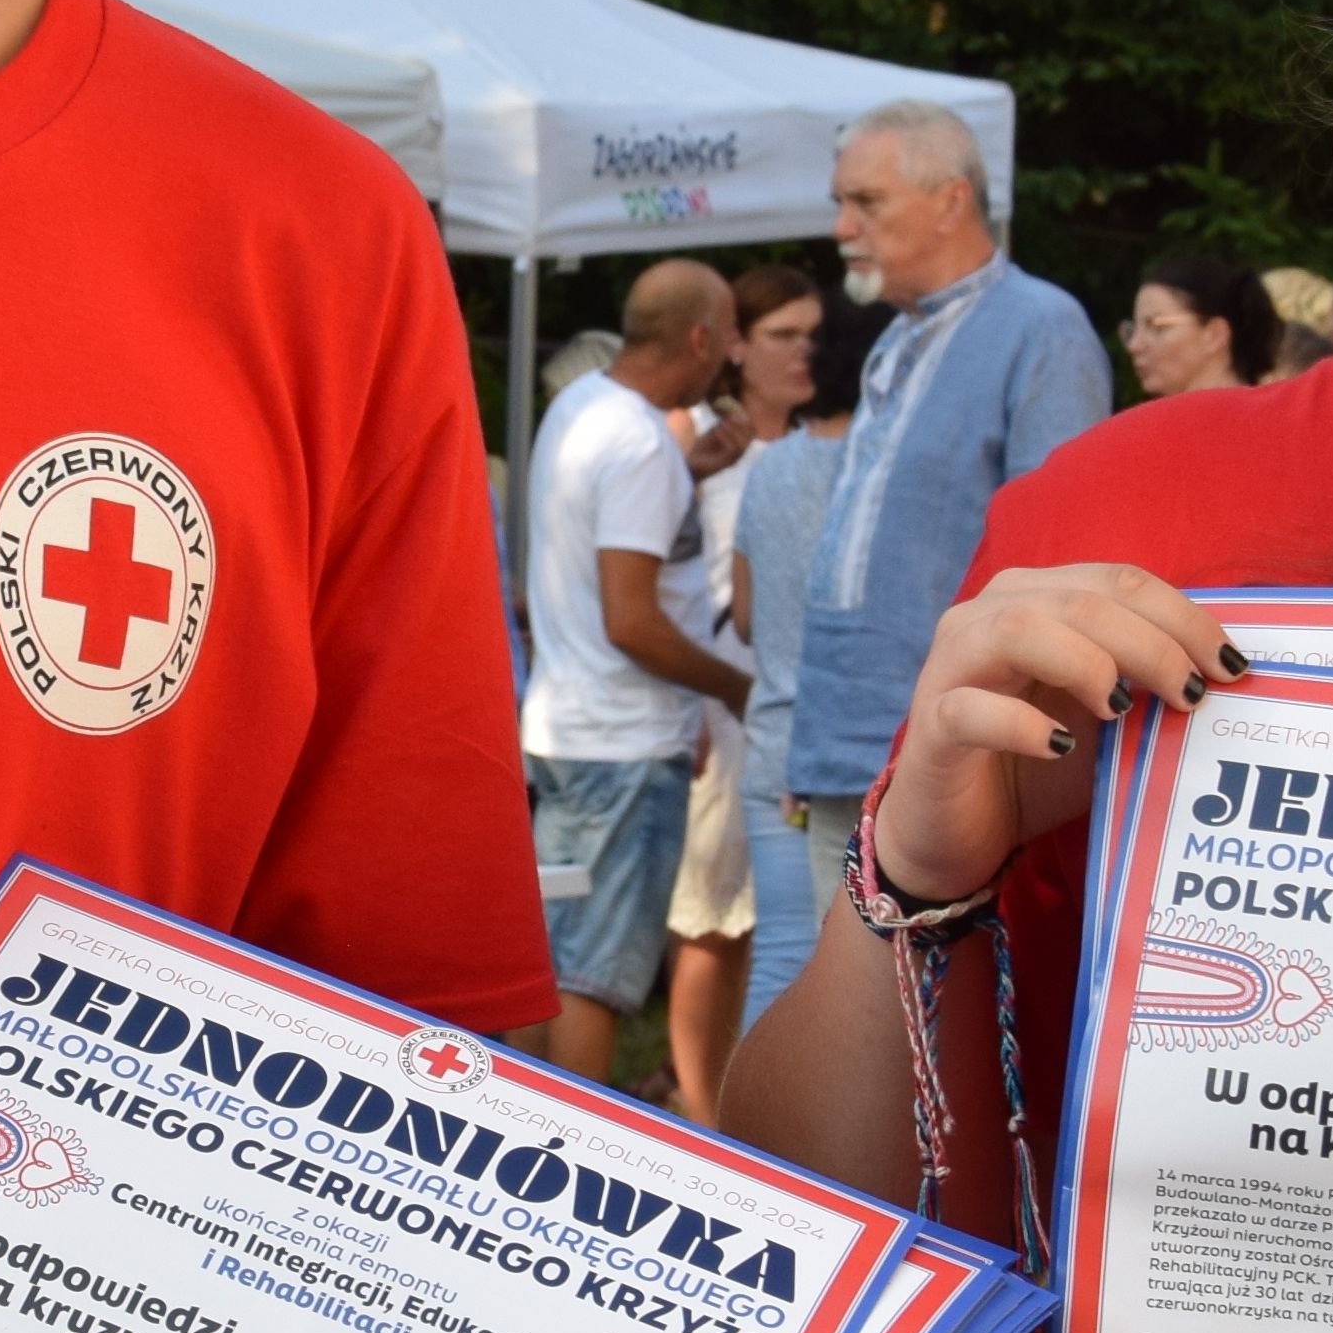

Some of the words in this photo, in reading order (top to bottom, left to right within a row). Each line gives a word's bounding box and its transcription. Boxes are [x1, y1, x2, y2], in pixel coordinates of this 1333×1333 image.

[17, 447, 206, 560] CZERWONY
[130, 583, 206, 715] KRZYŻ
[1212, 718, 1330, 749] GAZETKA
[42, 922, 152, 974] GAZETKA
[156, 967, 389, 1067] OKOLICZNOŚCIOWA
[402, 1038, 418, 1076] POLSKI
[420, 1031, 486, 1066] CZERWONY
[1205, 1067, 1249, 1105] W
[0, 952, 796, 1303] JEDNODNIÓWKA
[1249, 1123, 1309, 1156] na
[476, 1092, 582, 1143] MSZANA
[586, 1135, 676, 1184] DOLNA,
[684, 1175, 824, 1240] 30.08.2024
[1157, 1168, 1177, 1181] 14
[1181, 1174, 1235, 1188] marca
[1240, 1178, 1282, 1193] 1994
[1287, 1186, 1324, 1199] roku
[231, 1139, 571, 1287] CZERWONEGO
[292, 1206, 309, 1222] z
[313, 1215, 390, 1253] okazji
[304, 1130, 498, 1217] ODDZIAŁU
[502, 1207, 785, 1329] OKRĘGOWEGO
[1153, 1221, 1229, 1239] Krzyżowi
[1154, 1205, 1247, 1224] przekazało
[1251, 1216, 1266, 1226] w
[1270, 1216, 1318, 1232] darze
[111, 1183, 240, 1248] Centrum
[243, 1233, 394, 1313] Integracji,
[201, 1253, 214, 1269] i
[203, 1196, 344, 1261] ukończenia
[348, 1253, 458, 1304] remontu
[1151, 1241, 1241, 1262] utworzony
[1245, 1250, 1296, 1265] został
[1148, 1278, 1223, 1296] trwająca
[1226, 1283, 1251, 1299] już
[1255, 1286, 1277, 1299] 30
[1281, 1288, 1304, 1302] lat
[1150, 1258, 1278, 1284] Rehabilitacyjny
[1283, 1270, 1321, 1285] PCK.
[1146, 1298, 1292, 1320] czerwonokrzyska
[1297, 1311, 1318, 1322] na
